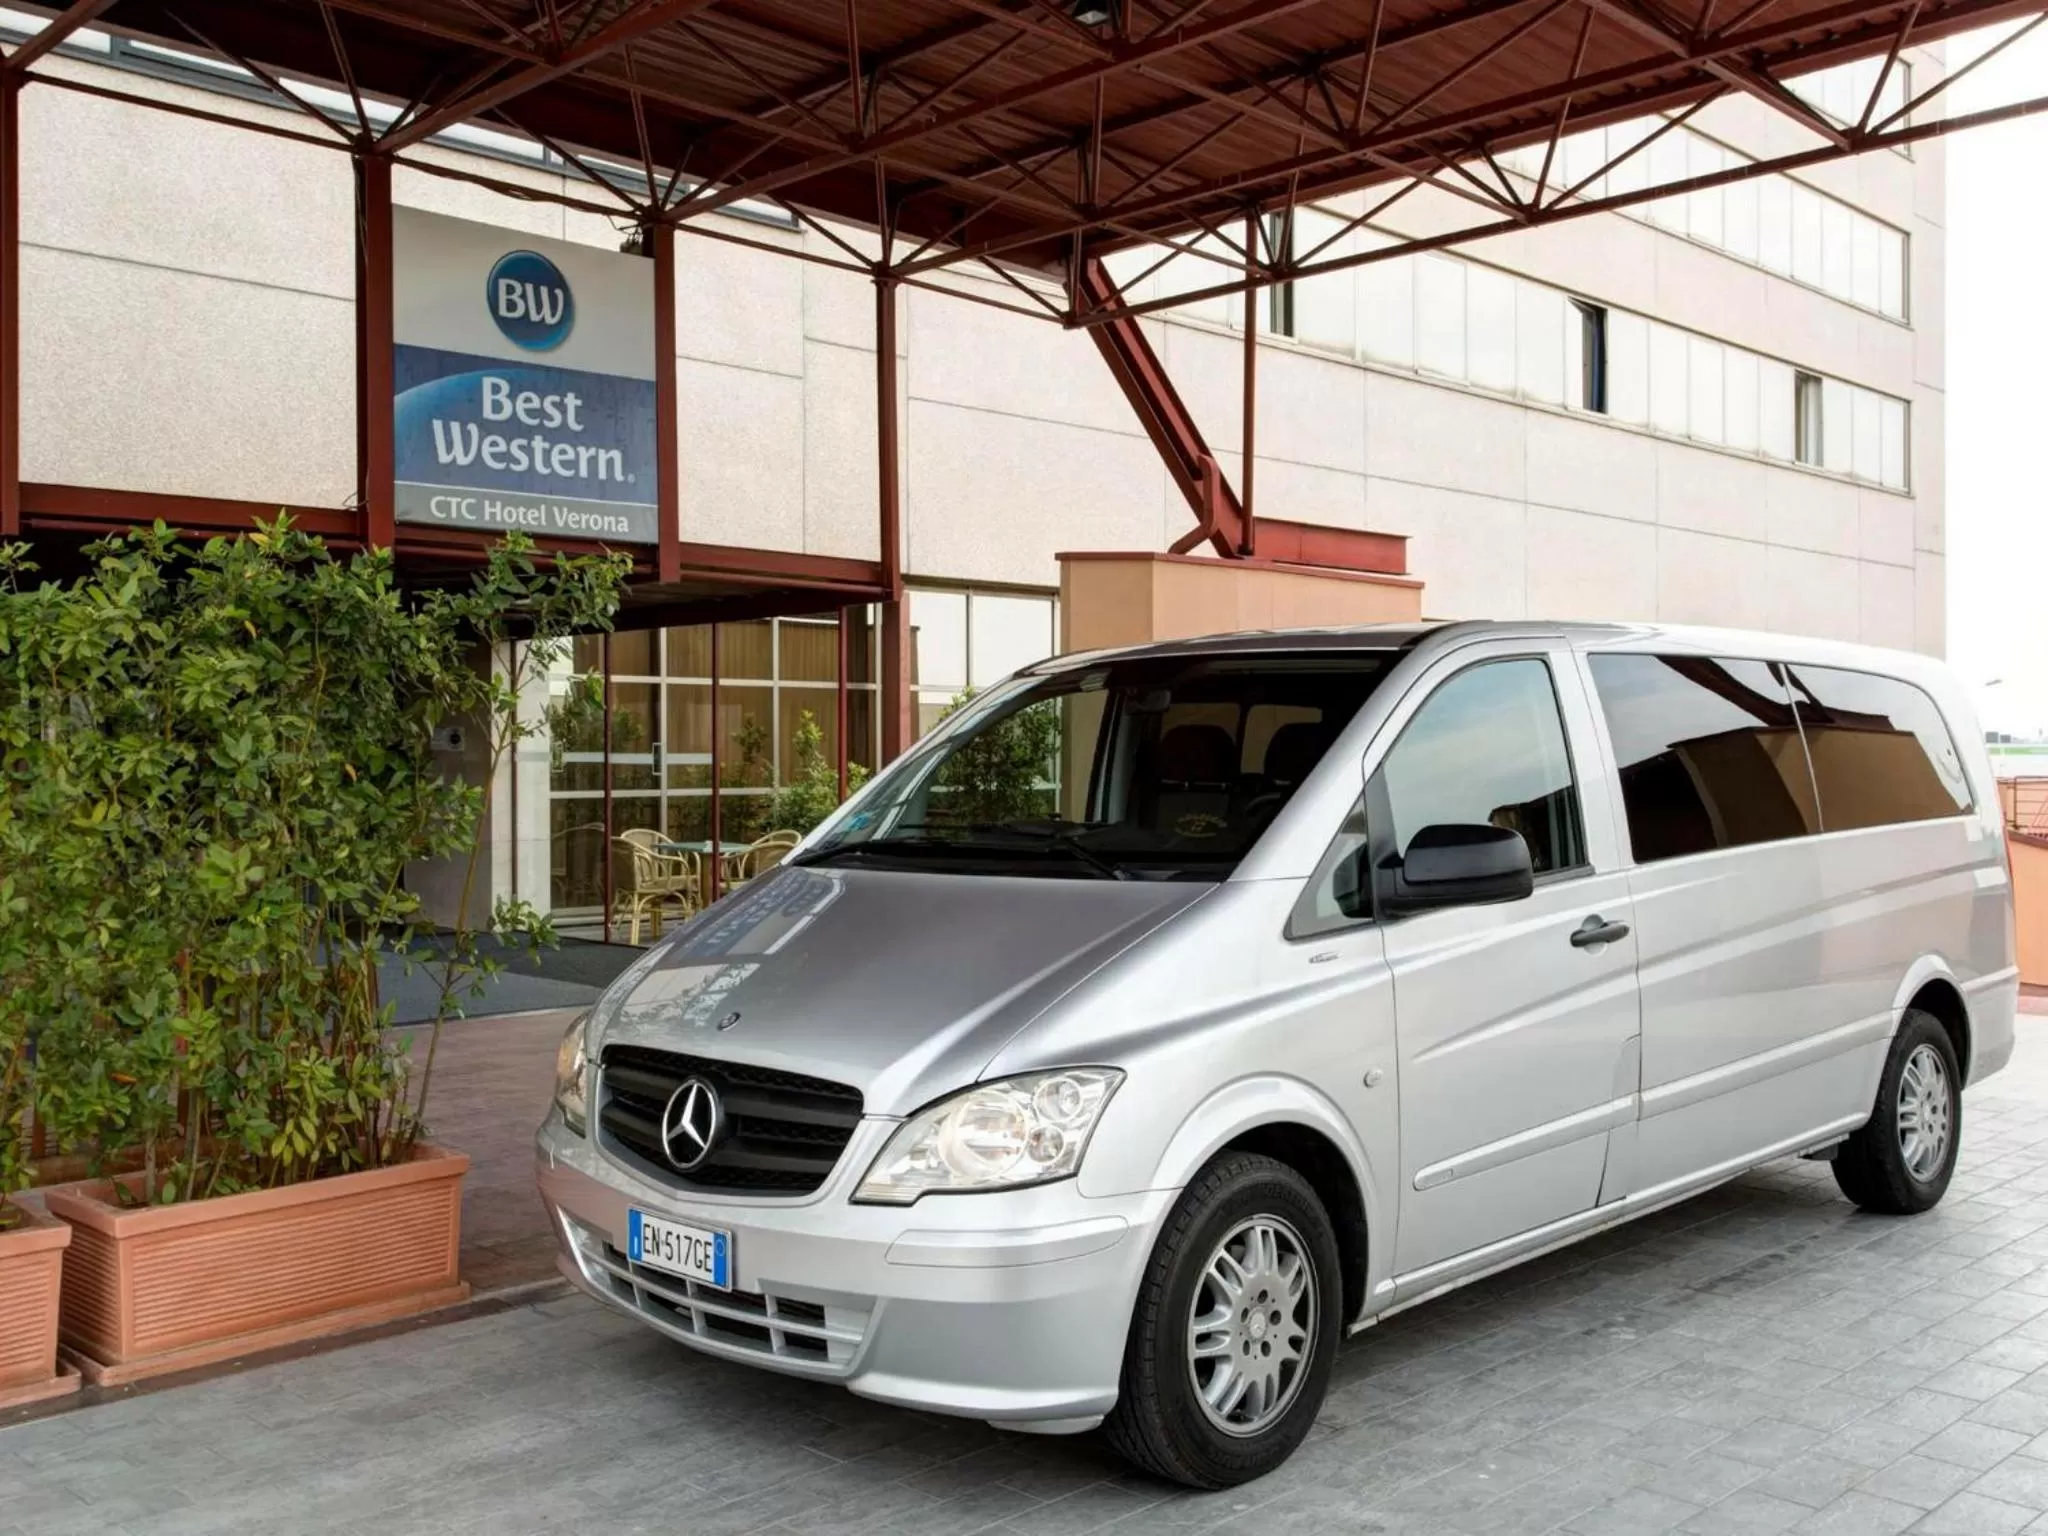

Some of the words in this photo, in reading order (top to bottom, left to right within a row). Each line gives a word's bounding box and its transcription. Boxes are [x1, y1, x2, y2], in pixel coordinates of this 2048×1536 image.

[497, 278, 564, 324] BW
[482, 376, 584, 431] Best
[432, 418, 626, 482] Western
[429, 496, 476, 520] CTC
[484, 500, 546, 525] Hotel
[552, 505, 629, 534] Verona
